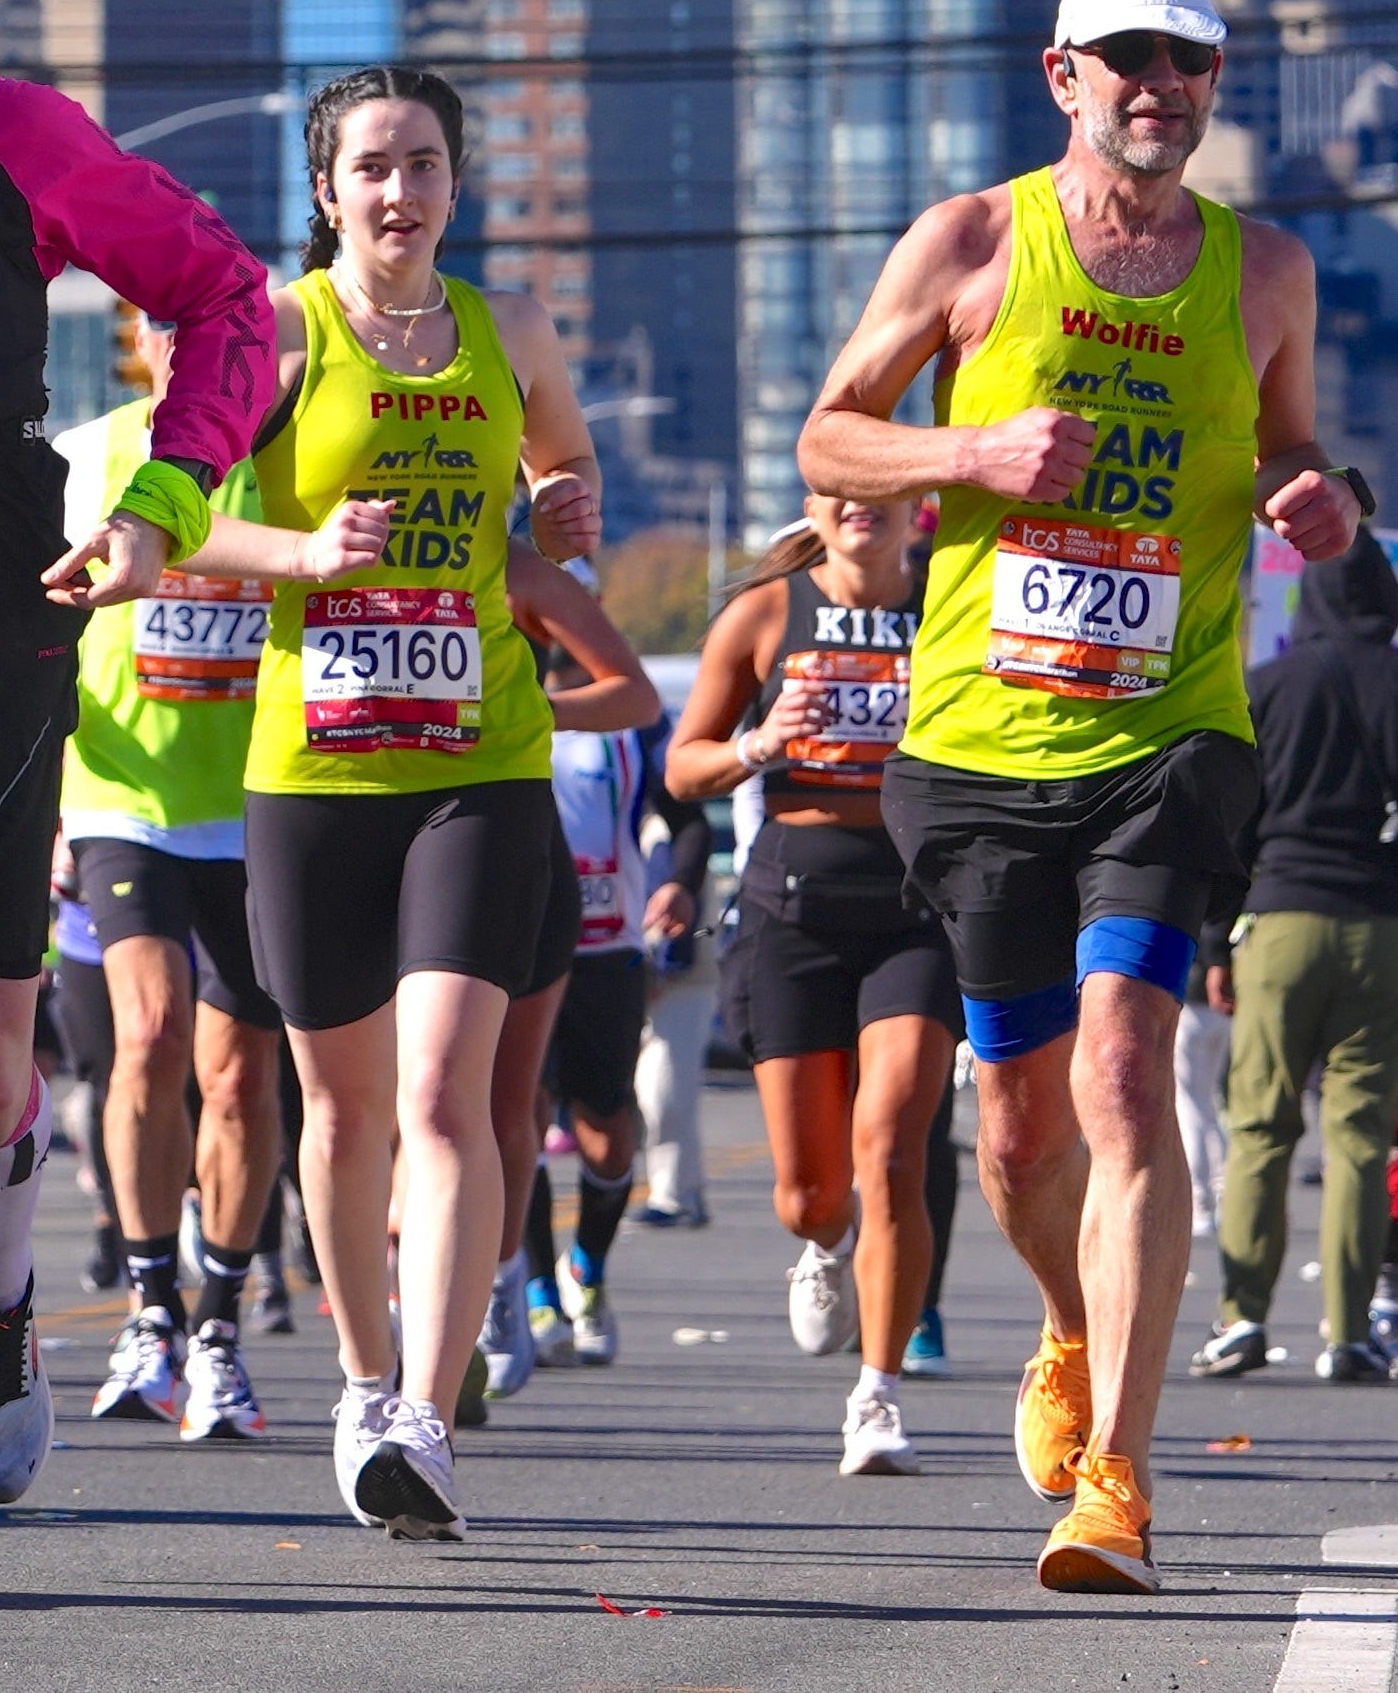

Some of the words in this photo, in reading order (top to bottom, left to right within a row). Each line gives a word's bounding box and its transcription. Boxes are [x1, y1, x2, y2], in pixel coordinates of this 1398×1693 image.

[1061, 306, 1185, 356] Wolfie
[370, 392, 488, 421] PIPPA
[1049, 397, 1072, 406] NEW
[1075, 400, 1100, 410] YORK
[1102, 404, 1128, 413] ROAD
[1130, 407, 1172, 418] RUNNERS
[1091, 422, 1185, 471] AM
[1062, 468, 1176, 520] IDS
[1065, 528, 1090, 539] TATA
[1063, 546, 1101, 558] SERVICES
[1064, 537, 1119, 553] CONSULTANCY
[1130, 554, 1160, 566] TATA
[1021, 563, 1150, 629] 6720
[433, 609, 459, 619] TATA
[145, 605, 268, 644] 43772
[1109, 630, 1120, 641] C
[319, 629, 469, 682] 25160
[1121, 656, 1140, 668] VIP
[1146, 659, 1169, 672] TFK
[1110, 673, 1149, 689] 2024
[337, 684, 344, 695] 2
[406, 684, 415, 694] E
[422, 723, 463, 740] 2024
[419, 736, 429, 747] B
